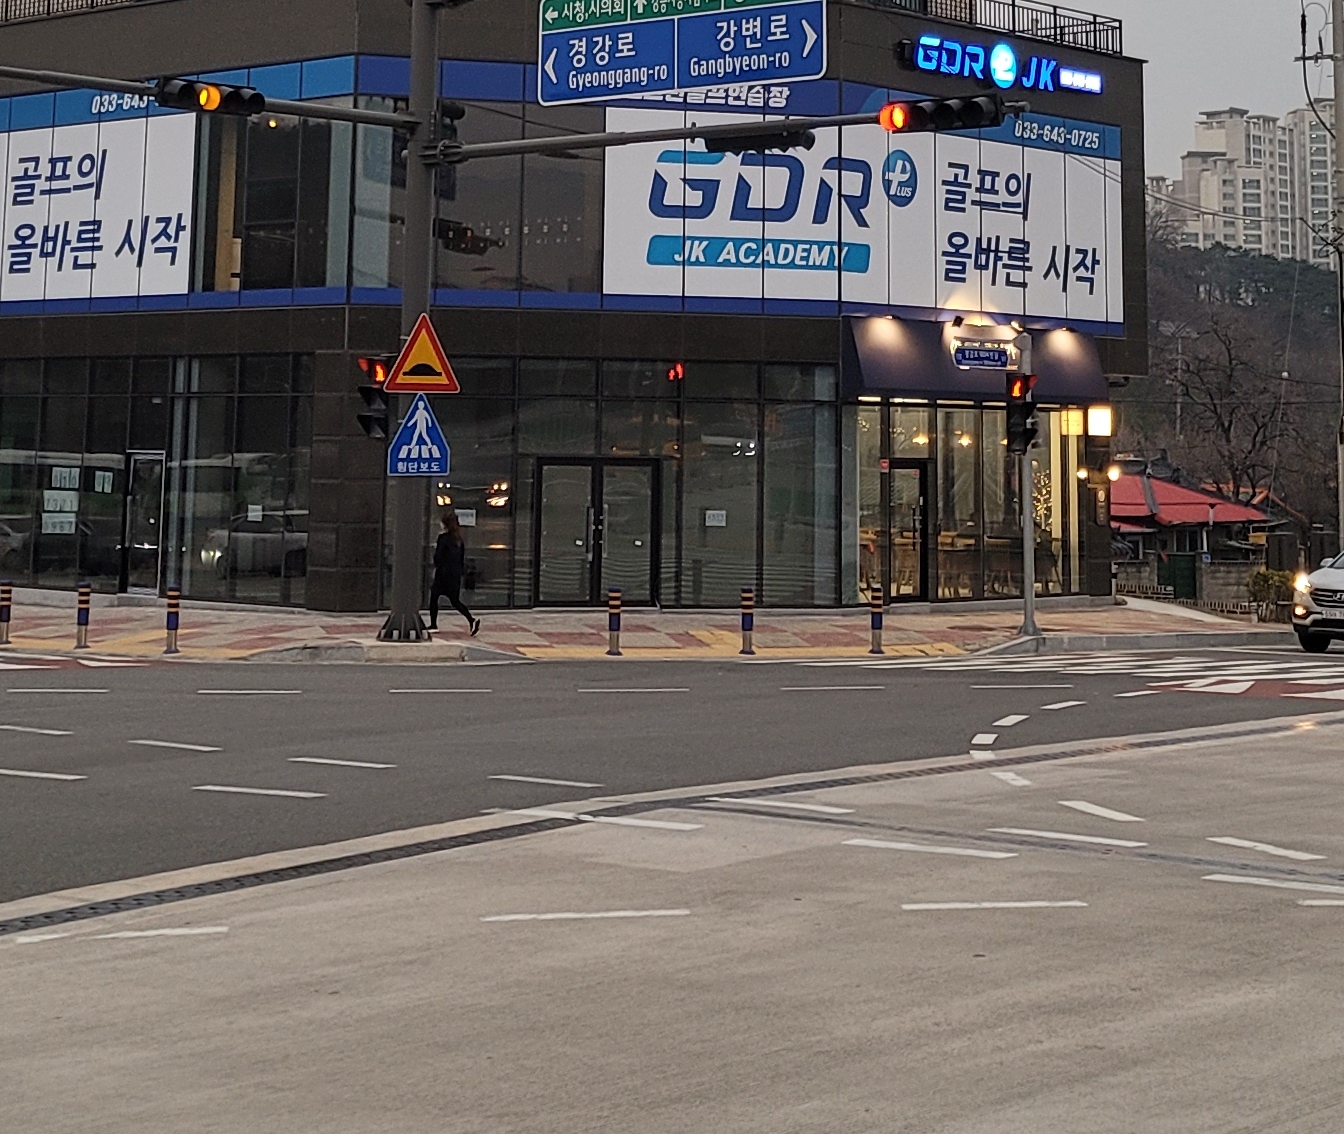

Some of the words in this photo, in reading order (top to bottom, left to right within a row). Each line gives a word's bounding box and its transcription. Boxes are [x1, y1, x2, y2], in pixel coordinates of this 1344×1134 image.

[568, 31, 637, 68] 경강로
[716, 14, 791, 52] 강변로
[568, 64, 668, 92] Gyeonggang-ro
[689, 50, 790, 78] Gangbyeon-ro
[917, 36, 985, 80] GDR
[1021, 56, 1058, 92] JK
[1013, 119, 1100, 149] 033-643-0725
[10, 148, 108, 207] 골프의
[649, 149, 871, 229] GDR
[940, 161, 1032, 222] 골프의
[6, 219, 104, 275] 올바른
[114, 212, 187, 268] 시작
[673, 239, 710, 264] JK
[716, 240, 849, 267] ACADEMY
[940, 231, 1034, 289] 올바른
[1042, 244, 1101, 296] 시작
[396, 460, 442, 473] 횡단보도
